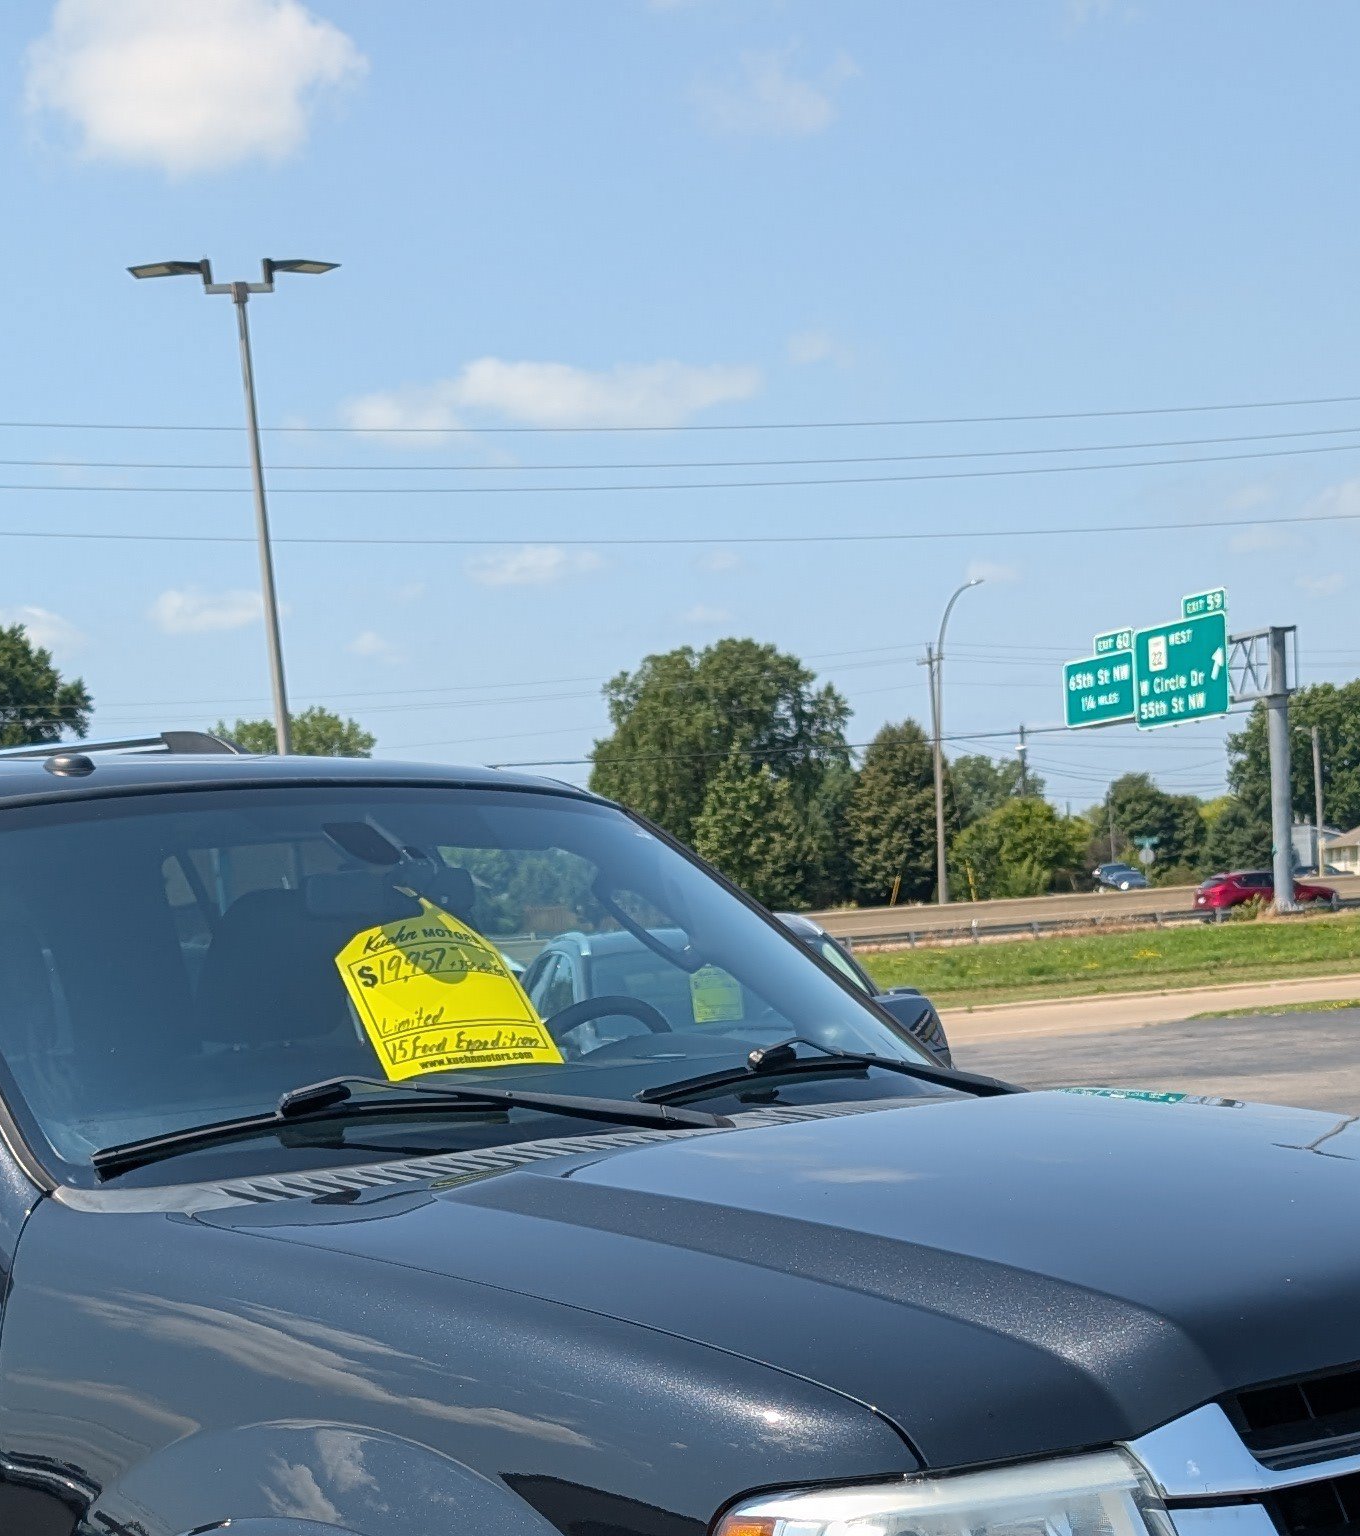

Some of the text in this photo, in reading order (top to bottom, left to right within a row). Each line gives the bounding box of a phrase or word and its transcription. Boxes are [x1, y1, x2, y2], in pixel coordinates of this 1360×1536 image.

[1187, 593, 1222, 613] EXIT 59
[1116, 633, 1131, 650] 60
[1168, 630, 1193, 646] WEST
[1069, 664, 1131, 691] 65th St NW
[1153, 675, 1188, 694] Circle
[1191, 670, 1206, 687] Dr
[1140, 692, 1207, 720] 55th St NW
[363, 926, 418, 954] Kuehn
[383, 1006, 445, 1034] Limited
[392, 1039, 409, 1063] 15
[412, 1036, 448, 1059] Ford
[419, 1051, 534, 1069] www.kuehnmotors.com
